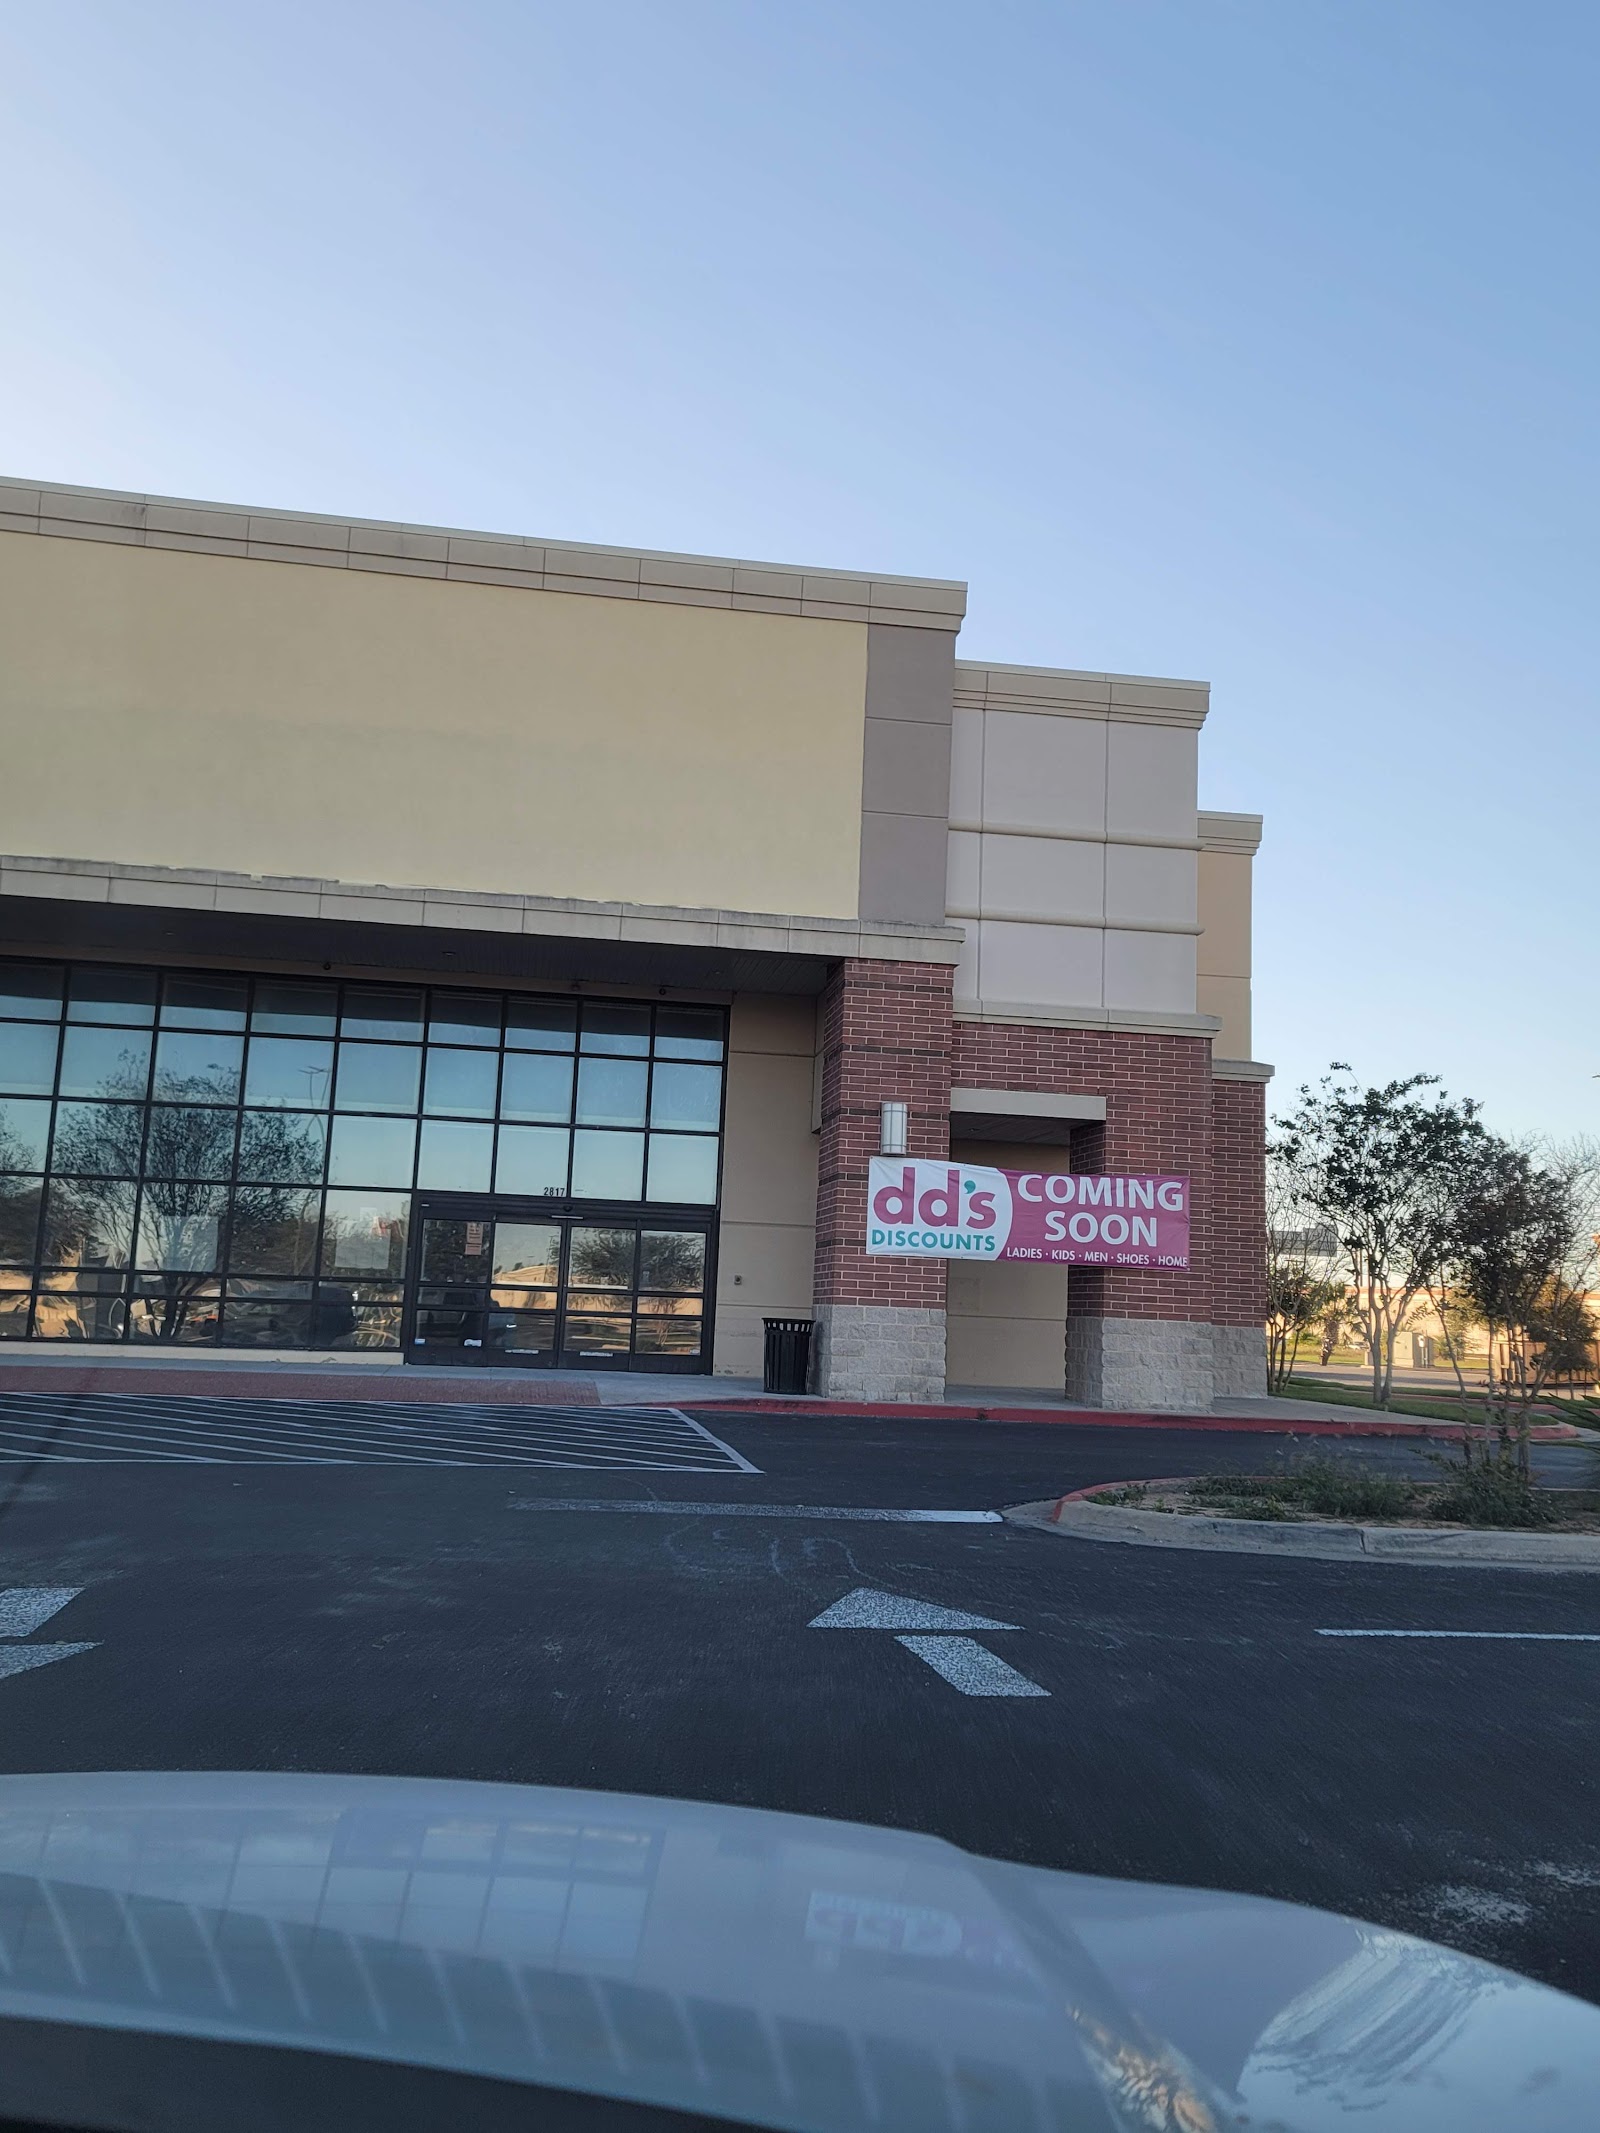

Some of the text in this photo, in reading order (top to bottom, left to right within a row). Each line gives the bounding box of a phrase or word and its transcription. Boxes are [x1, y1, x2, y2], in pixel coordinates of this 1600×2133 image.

[544, 1186, 565, 1197] 2817
[873, 1166, 997, 1230] dd's
[1017, 1174, 1184, 1211] COMING
[871, 1229, 996, 1252] DISCOUNTS
[1044, 1211, 1158, 1247] SOON
[1006, 1246, 1188, 1267] LADIES KIDS MEN SHOES HOME
